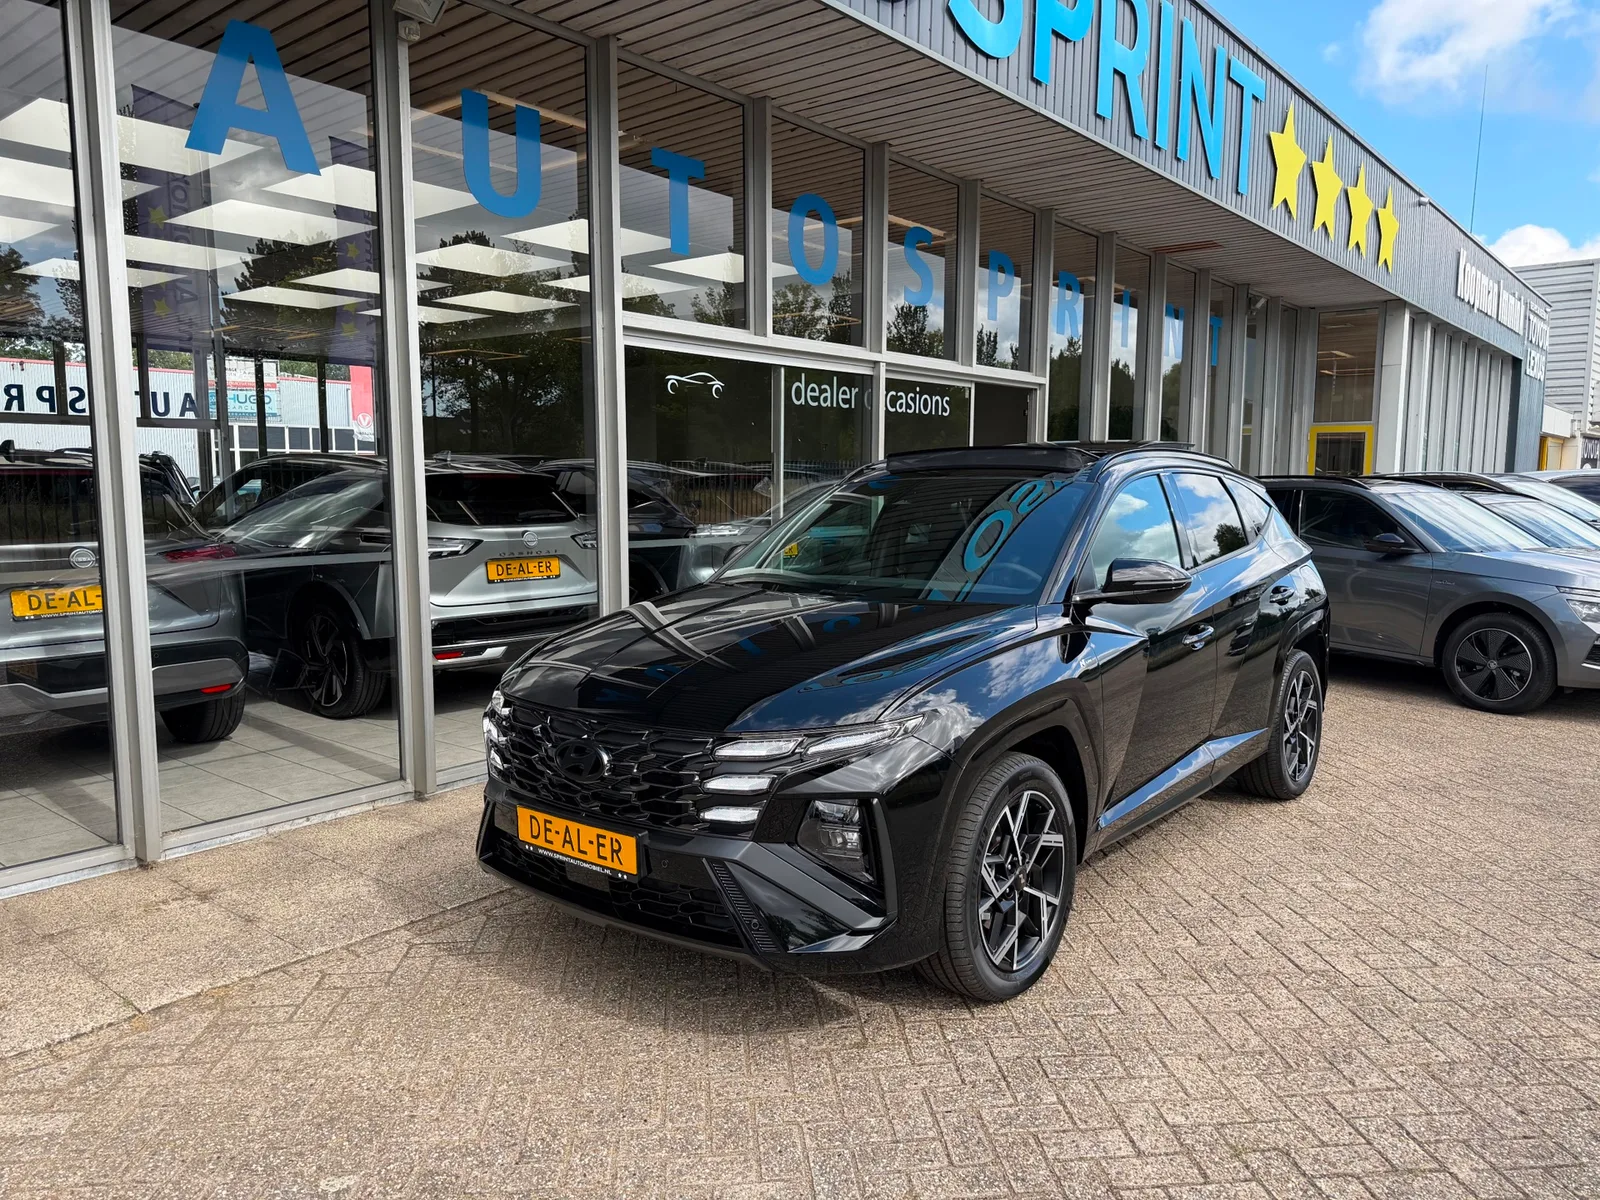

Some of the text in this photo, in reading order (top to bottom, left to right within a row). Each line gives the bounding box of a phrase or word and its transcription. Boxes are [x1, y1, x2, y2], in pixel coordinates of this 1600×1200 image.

[1457, 247, 1498, 320] Koopman
[791, 372, 951, 417] dealer casions
[496, 561, 553, 577] DE-AL-ER
[529, 814, 624, 866] DE-AL-ER
